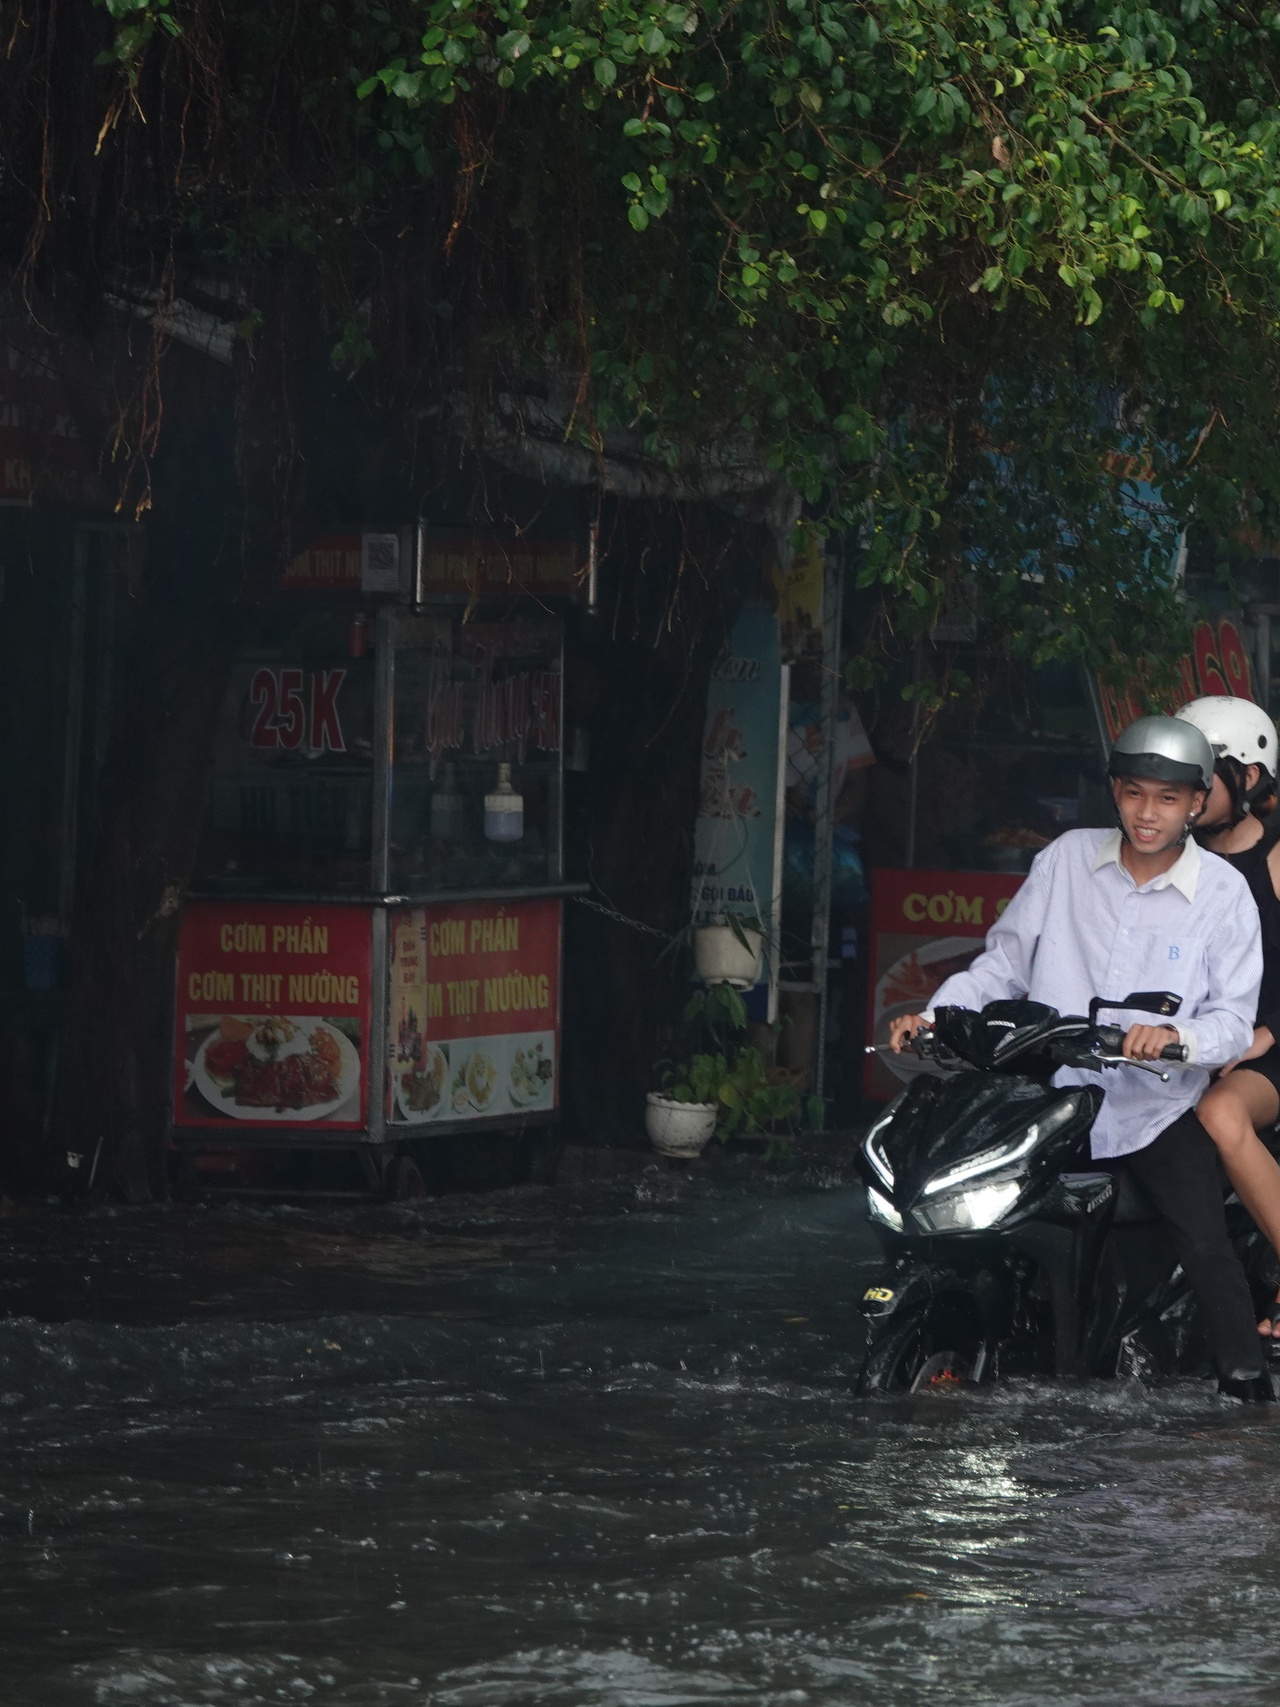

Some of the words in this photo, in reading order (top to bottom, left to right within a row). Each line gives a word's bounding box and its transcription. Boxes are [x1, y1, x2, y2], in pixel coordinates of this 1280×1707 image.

[250, 668, 347, 752] 25K
[902, 889, 985, 925] CƠM
[220, 921, 267, 953] CƠM
[272, 914, 329, 954] PHẦN
[429, 918, 467, 956] CƠM
[470, 906, 519, 954] PHẦN
[1167, 945, 1180, 960] B
[188, 970, 236, 1001] CƠM
[240, 972, 283, 1009] THỊT
[288, 968, 360, 1005] NƯỚNG
[446, 978, 480, 1023] THỊT
[484, 969, 550, 1013] NƯỚNG
